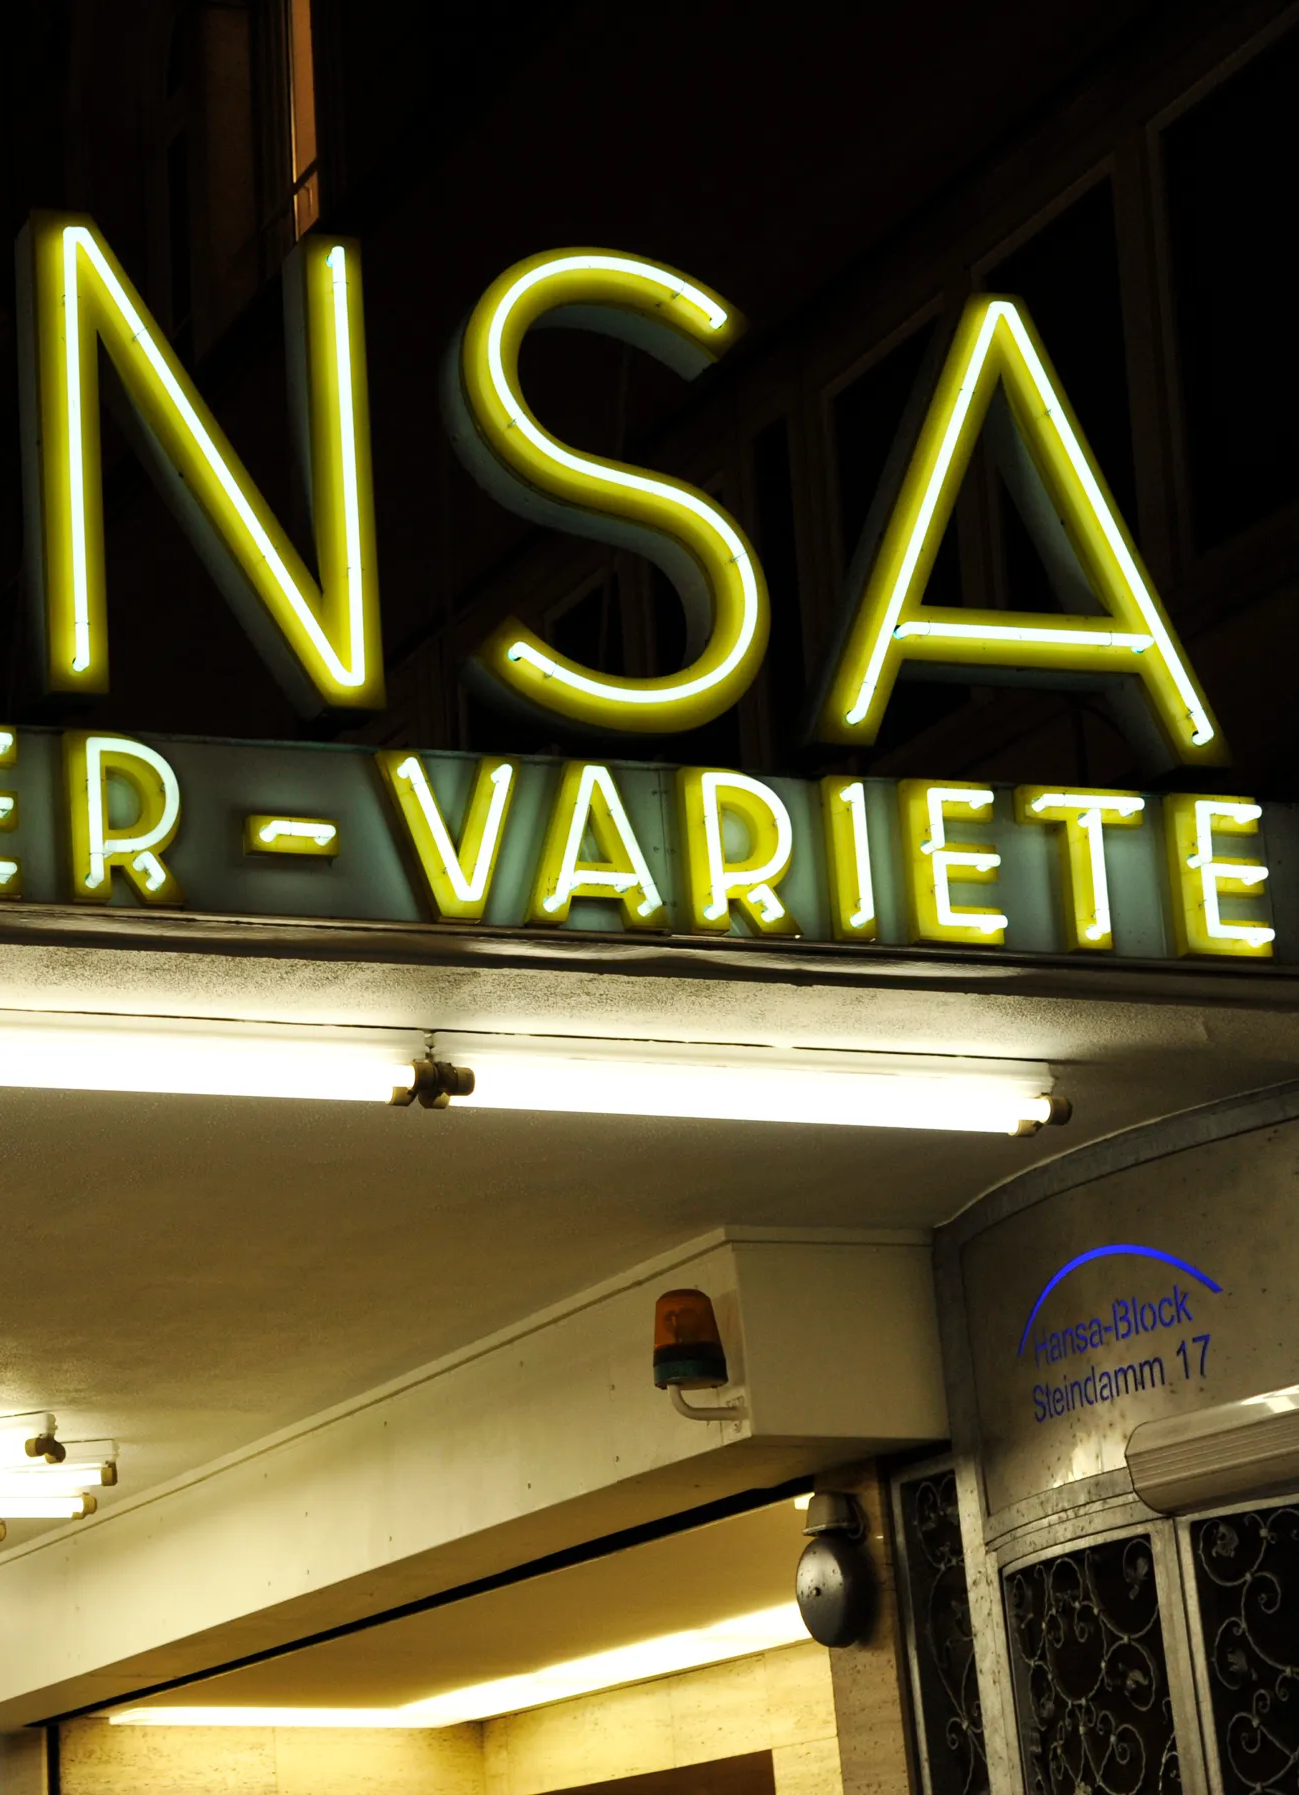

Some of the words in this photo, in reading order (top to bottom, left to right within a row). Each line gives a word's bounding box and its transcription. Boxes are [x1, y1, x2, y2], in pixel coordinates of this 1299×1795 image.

[375, 749, 1274, 957] VARIETE
[1032, 1285, 1193, 1369] Hansa-Block
[1032, 1357, 1165, 1423] Steindamm
[1176, 1335, 1211, 1380] 17
